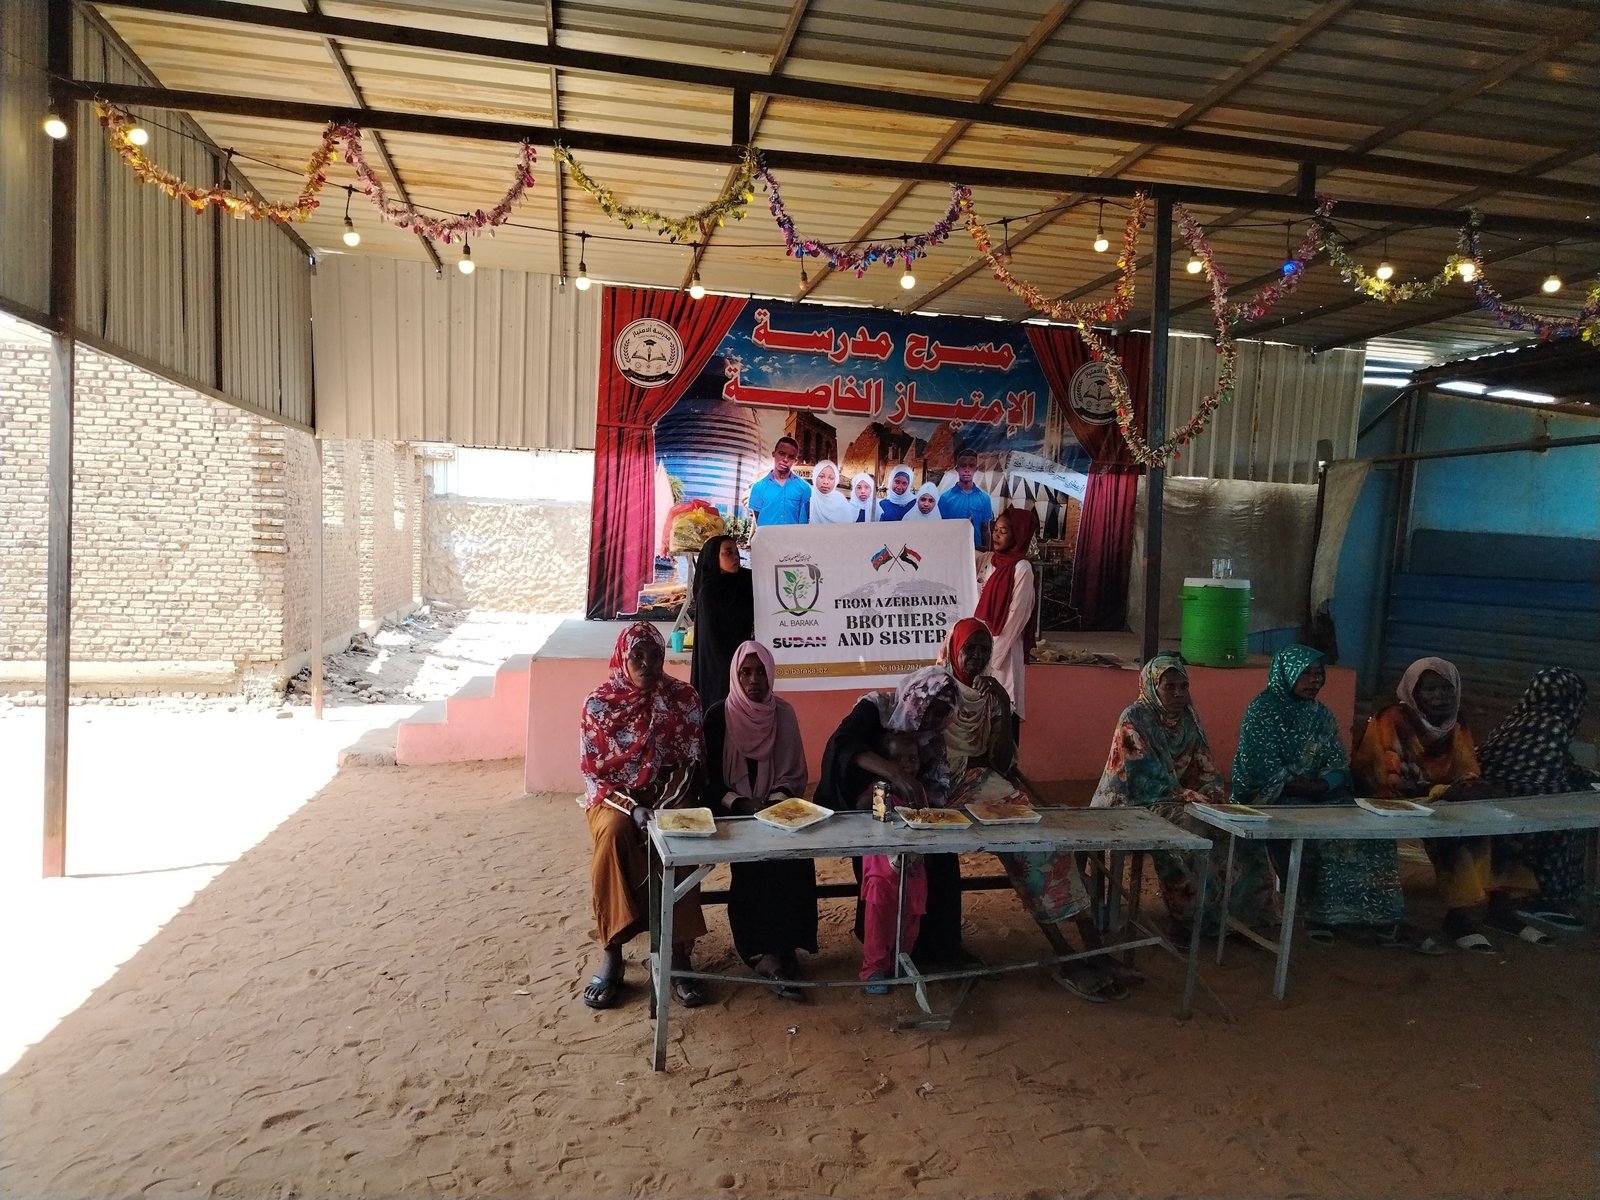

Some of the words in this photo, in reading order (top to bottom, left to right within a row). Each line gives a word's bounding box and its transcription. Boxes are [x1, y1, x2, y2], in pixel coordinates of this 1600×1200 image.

[752, 308, 894, 363] مدرسة
[903, 333, 1017, 371] مسرح
[723, 364, 885, 415] الخاصة
[834, 598, 872, 609] FROM
[875, 595, 957, 607] AZERBAIJAN
[790, 619, 819, 627] BARAKA
[846, 612, 947, 630] BROTHERS
[772, 636, 827, 648] SUDAN
[838, 631, 874, 647] AND
[879, 629, 948, 646] SISTER
